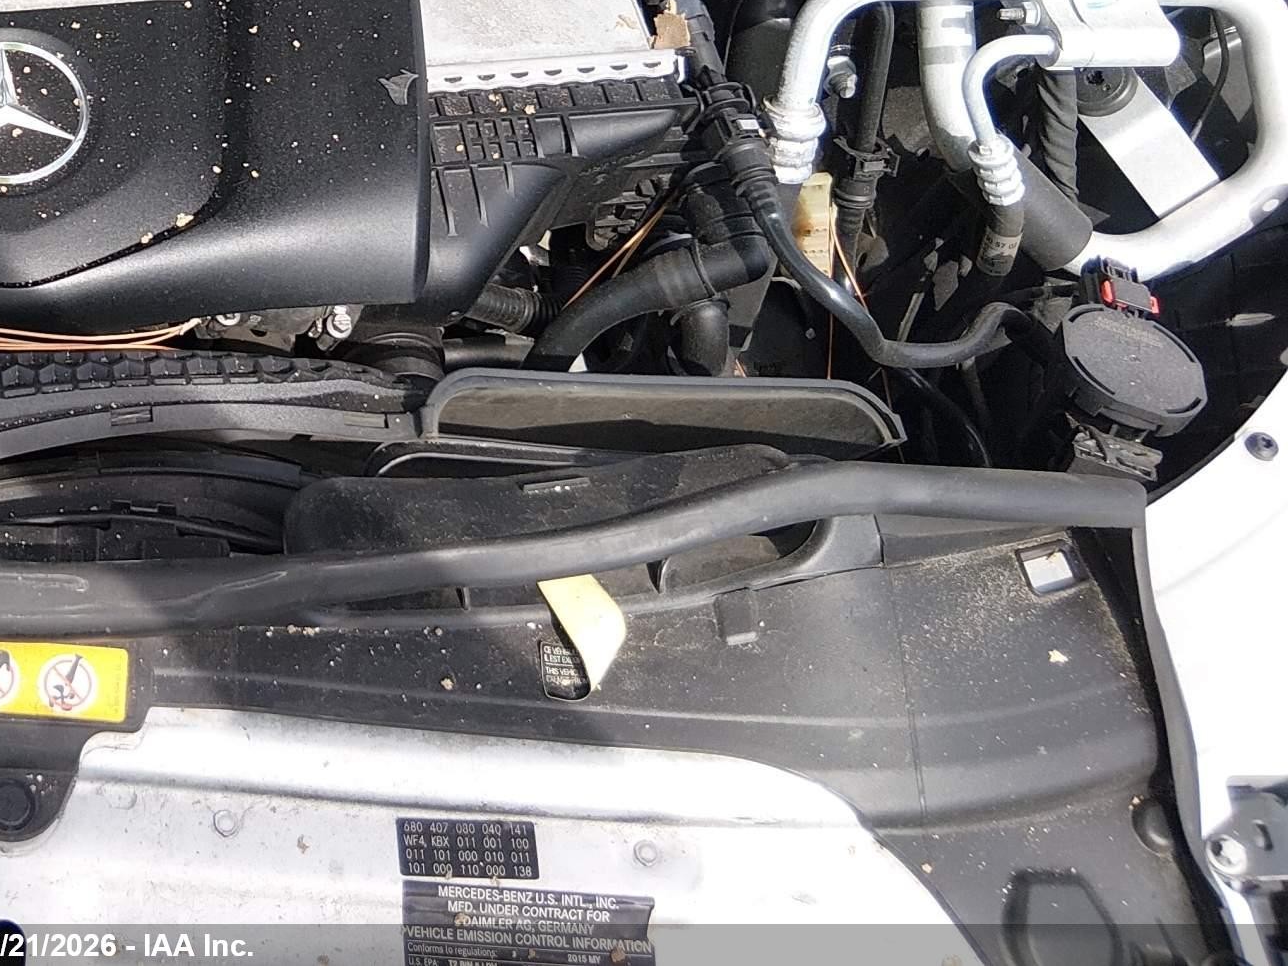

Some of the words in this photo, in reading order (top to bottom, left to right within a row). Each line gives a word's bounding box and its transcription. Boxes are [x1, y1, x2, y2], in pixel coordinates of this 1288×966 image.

[404, 821, 423, 832] 680
[430, 822, 449, 833] 407
[482, 824, 501, 835] 040
[457, 836, 476, 848] 011
[483, 837, 502, 849] 001
[511, 838, 529, 849] 100
[406, 849, 424, 860] 011
[433, 850, 451, 861] 101
[458, 850, 478, 861] 000
[484, 851, 504, 862] 010
[511, 852, 530, 863] 011
[409, 862, 426, 874] 101
[433, 863, 453, 875] 000
[461, 864, 479, 875] 110
[486, 865, 505, 876] 000
[514, 865, 532, 877] 138
[438, 885, 533, 904] MERCEDES-BENZ
[535, 893, 558, 905] U.S.
[595, 896, 620, 910] INC.
[447, 900, 476, 913] MFD.
[479, 902, 519, 916] UNDER
[522, 905, 583, 921] CONTRACT
[586, 909, 611, 923] FOR
[464, 916, 514, 930] DAIMLER
[515, 919, 535, 934] AG,
[537, 920, 595, 935] GERMANY
[406, 925, 454, 940] VEHICLE
[456, 929, 512, 945] EMISSION
[515, 933, 570, 948] CONTROL
[572, 936, 652, 953] INFORMATION
[407, 941, 444, 954] Conforms
[445, 945, 454, 954] to
[567, 953, 588, 964] 2015
